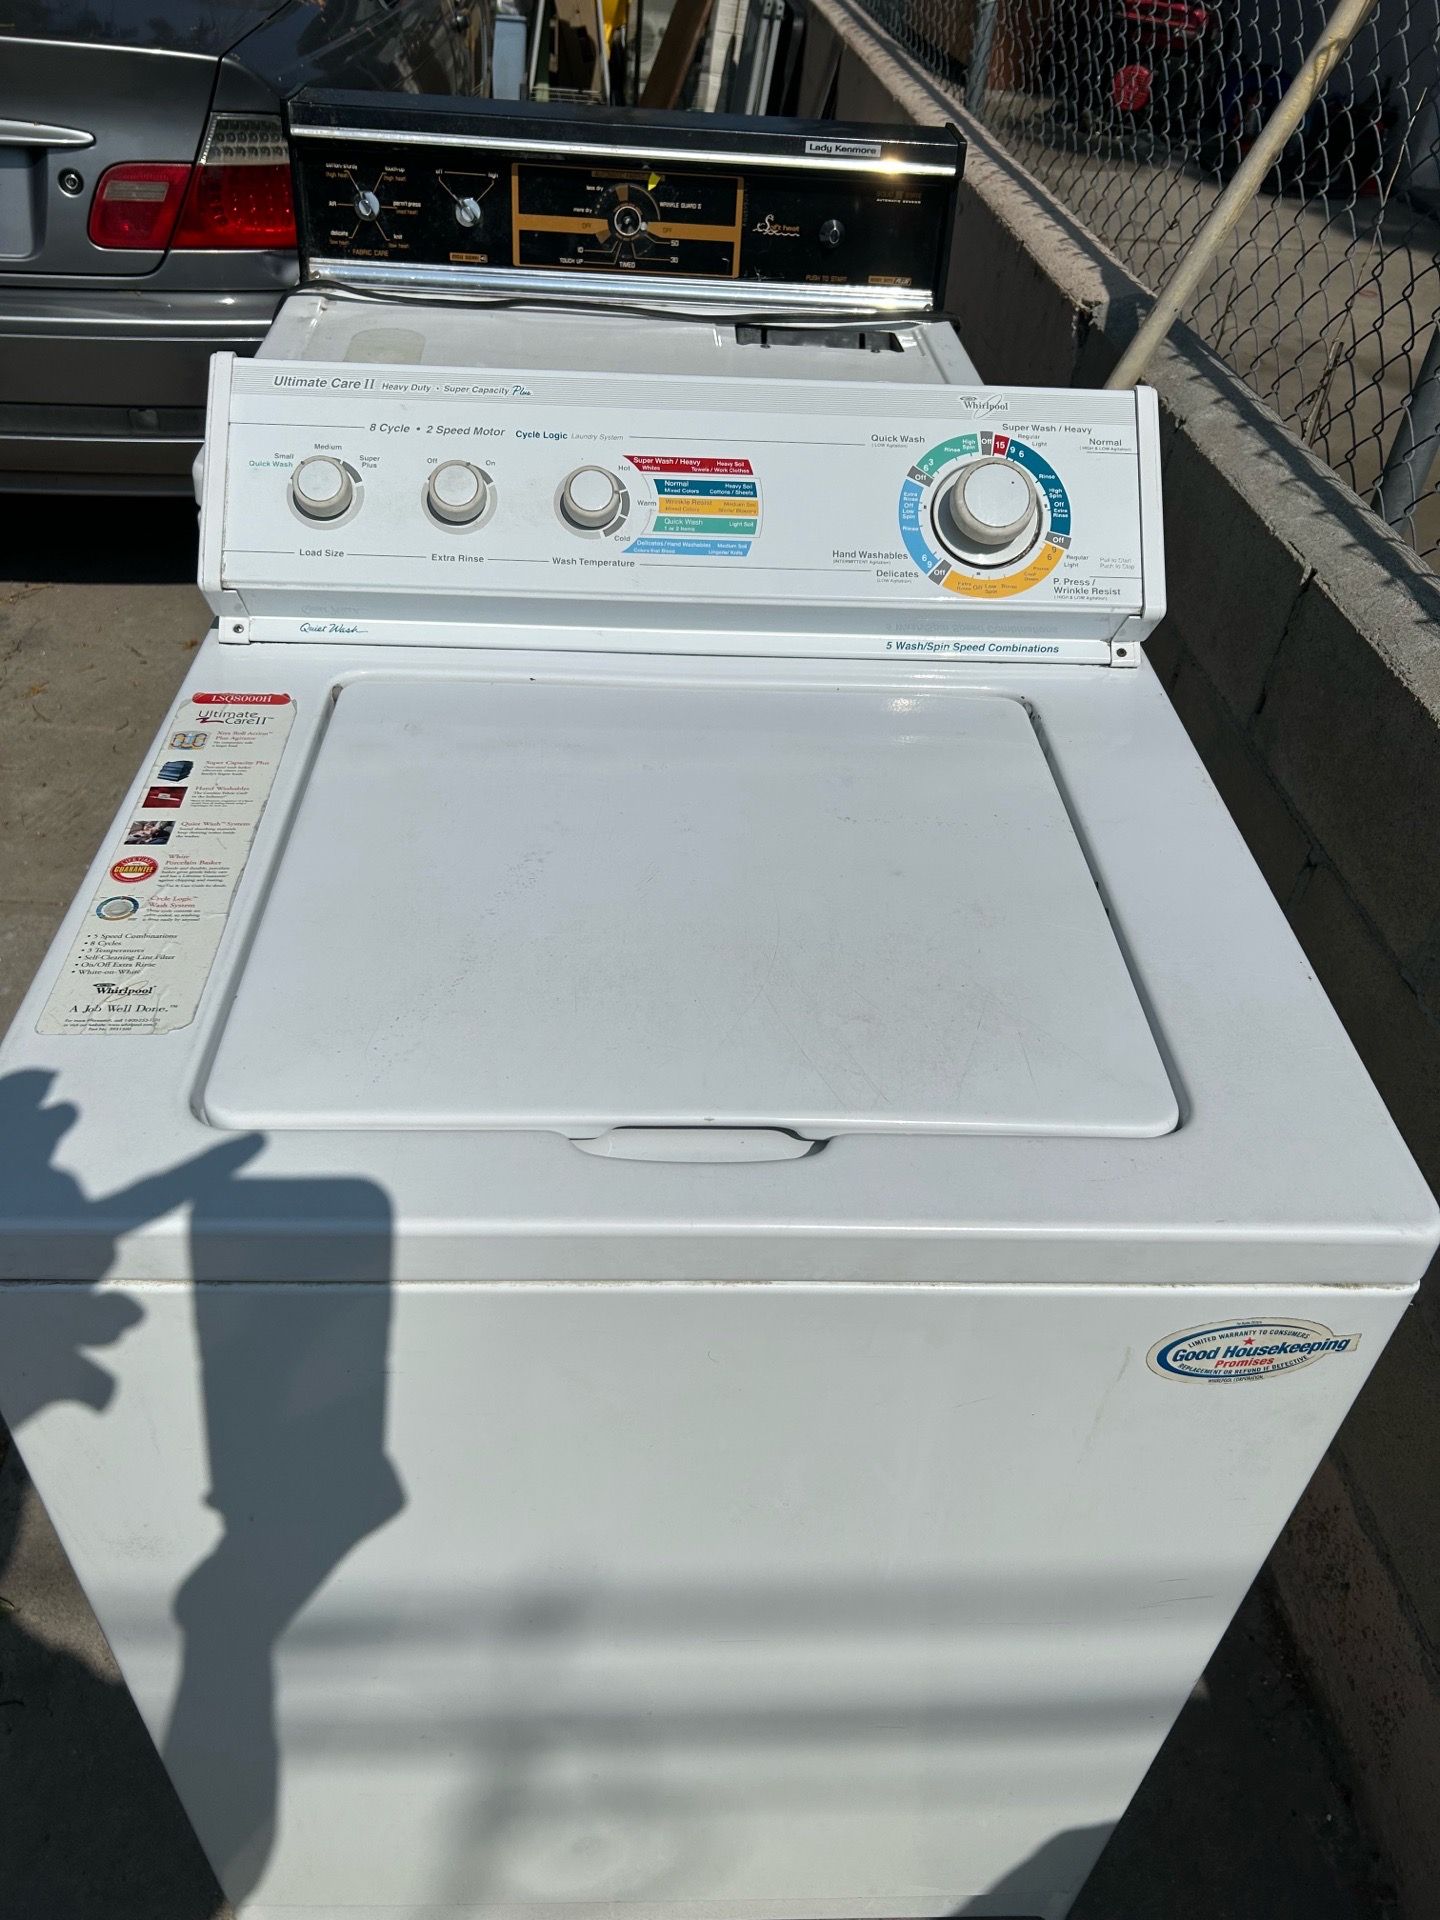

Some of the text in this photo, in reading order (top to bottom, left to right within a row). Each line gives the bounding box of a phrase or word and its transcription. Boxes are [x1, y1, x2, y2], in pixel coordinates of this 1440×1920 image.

[809, 143, 876, 154] Lady Kenmore
[659, 201, 680, 209] WRINKLE
[805, 273, 821, 281] PUSH
[274, 375, 328, 388] Ultimate
[331, 377, 361, 389] Care
[382, 382, 409, 392] Heavy
[410, 383, 432, 393] Duty
[443, 384, 469, 394] Super
[471, 385, 510, 396] Capacity
[512, 385, 531, 396] Plus
[963, 400, 1009, 411] Whirlpool
[369, 423, 506, 437] 8 Cycle 2 Speed Motor
[1002, 423, 1092, 435] Super Wash Heavy
[515, 430, 624, 441] Cycle Logic Laundry System
[871, 433, 926, 443] Quick Wash
[314, 443, 342, 451] Medium
[995, 441, 1006, 449] 15
[1089, 437, 1122, 447] Normal
[359, 454, 380, 463] Super
[485, 459, 496, 467] On
[633, 457, 654, 465] Super
[654, 457, 674, 465] Wash
[679, 459, 701, 467] Heavy
[716, 460, 733, 468] Heavy
[361, 461, 377, 469] Plus
[637, 499, 657, 507] Warm
[299, 549, 345, 558] Load Size
[431, 553, 485, 563] Extra Rinse
[832, 549, 909, 560] Hand Washables
[552, 556, 636, 569] Wash Temperature
[876, 569, 919, 578] Delicates
[1053, 577, 1091, 587] P. Press
[1053, 586, 1121, 596] Wrinkle Resist
[299, 622, 368, 634] Quiet Wash
[885, 640, 1060, 654] 5 Wash/Spin Speed Combinations
[211, 694, 272, 703] LSQ8000H
[198, 709, 258, 719] Ultimate
[97, 940, 122, 948] Cycles
[96, 986, 153, 996] Whirlpool
[69, 1004, 79, 1013] A
[82, 1004, 102, 1014] Job
[108, 1004, 132, 1013] Well
[1187, 1335, 1217, 1349] LIMITED
[1218, 1329, 1257, 1340] WARRANTY
[1269, 1329, 1310, 1340] CONSUMERS
[1172, 1338, 1352, 1363] Good Housekeeping
[1178, 1363, 1222, 1375] REPLACEMENT
[1234, 1367, 1262, 1375] REFUND
[1271, 1355, 1308, 1371] DEFECTIVE
[1214, 1357, 1275, 1369] Promises
